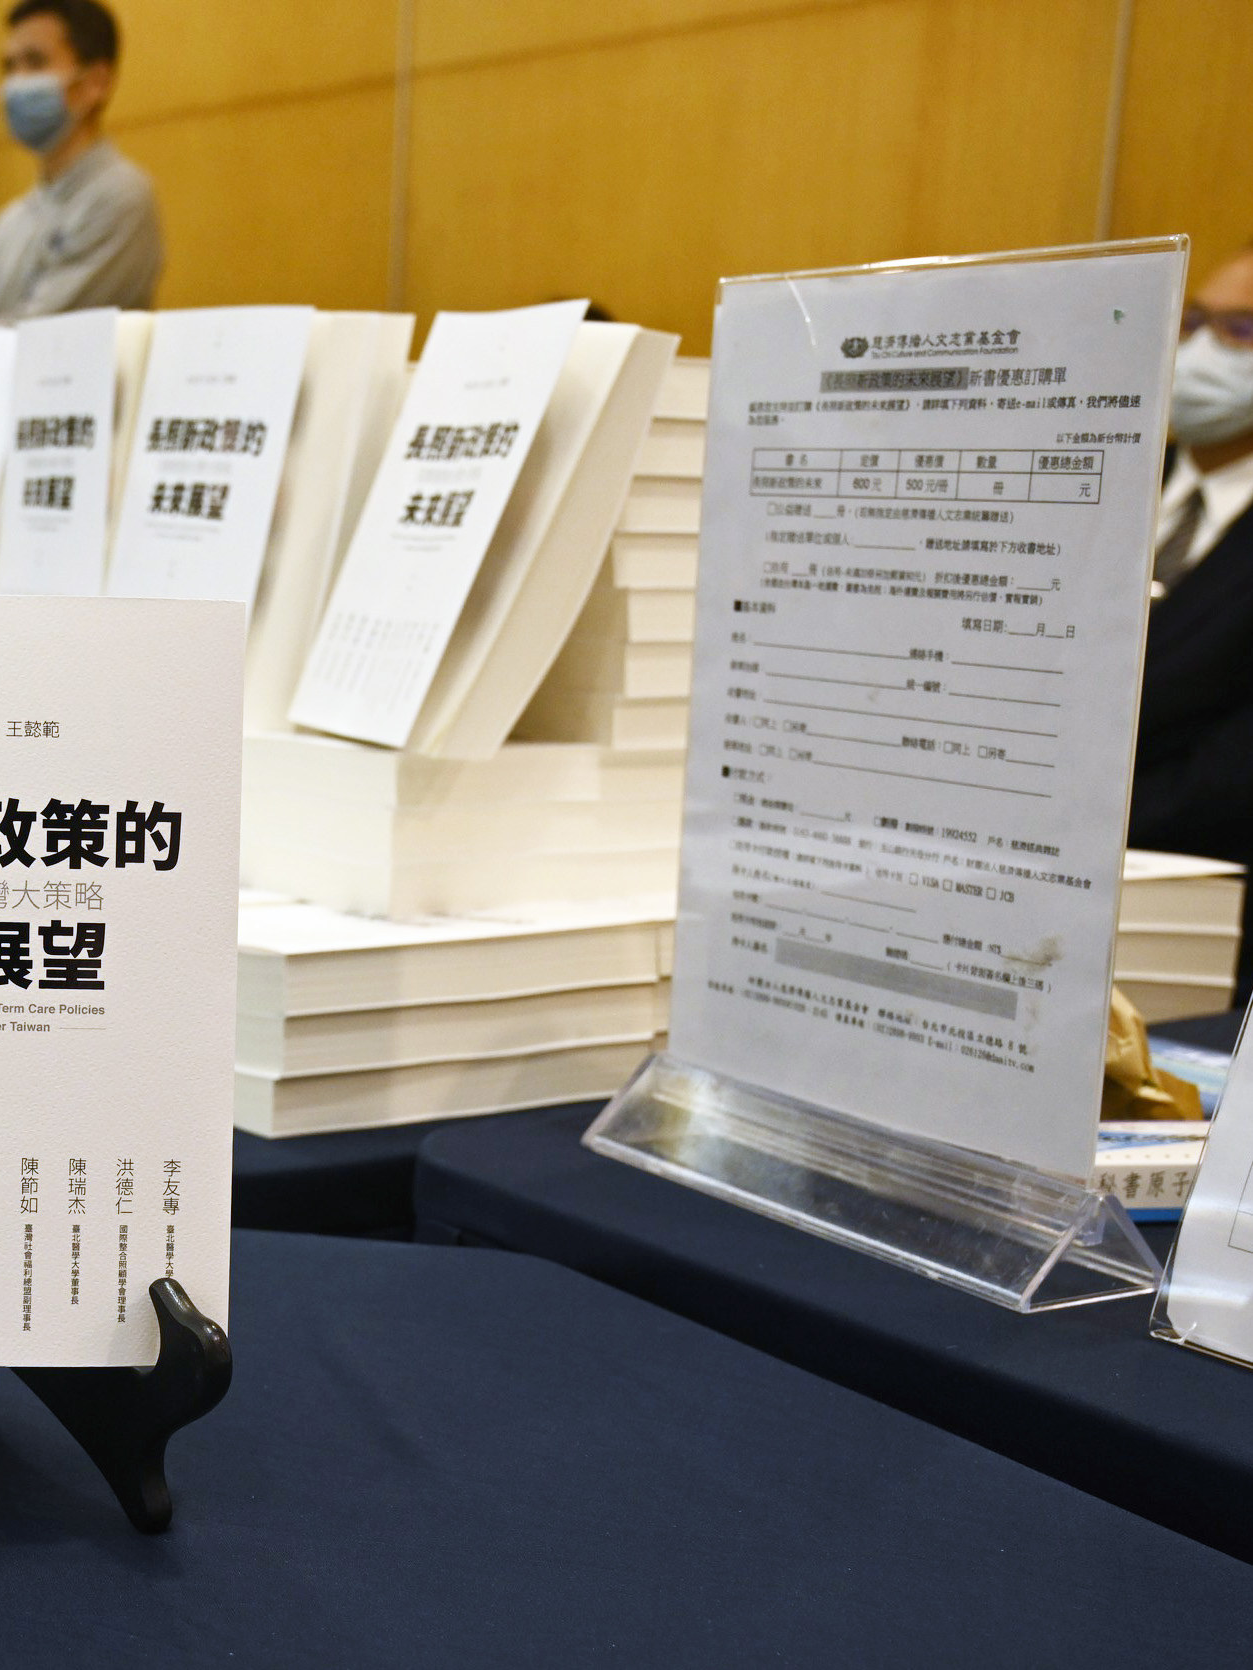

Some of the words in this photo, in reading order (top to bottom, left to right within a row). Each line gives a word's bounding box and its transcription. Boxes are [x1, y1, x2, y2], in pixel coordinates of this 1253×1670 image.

[1079, 483, 1091, 498] 元
[1051, 579, 1061, 591] 元
[1036, 622, 1045, 637] 月
[1066, 625, 1075, 639] 日
[6, 720, 60, 739] 王懿範
[10, 1021, 51, 1033] Taiwan
[28, 1003, 56, 1015] Care
[59, 1004, 105, 1016] Policies
[20, 1157, 39, 1214] 陳節如
[68, 1158, 87, 1215] 陳瑞杰
[115, 1158, 134, 1215] 洪德仁
[162, 1158, 182, 1215] 李友專
[70, 1224, 81, 1305] 臺北醫學大學董事長
[117, 1224, 128, 1323] 國際整合照顧學會理事長
